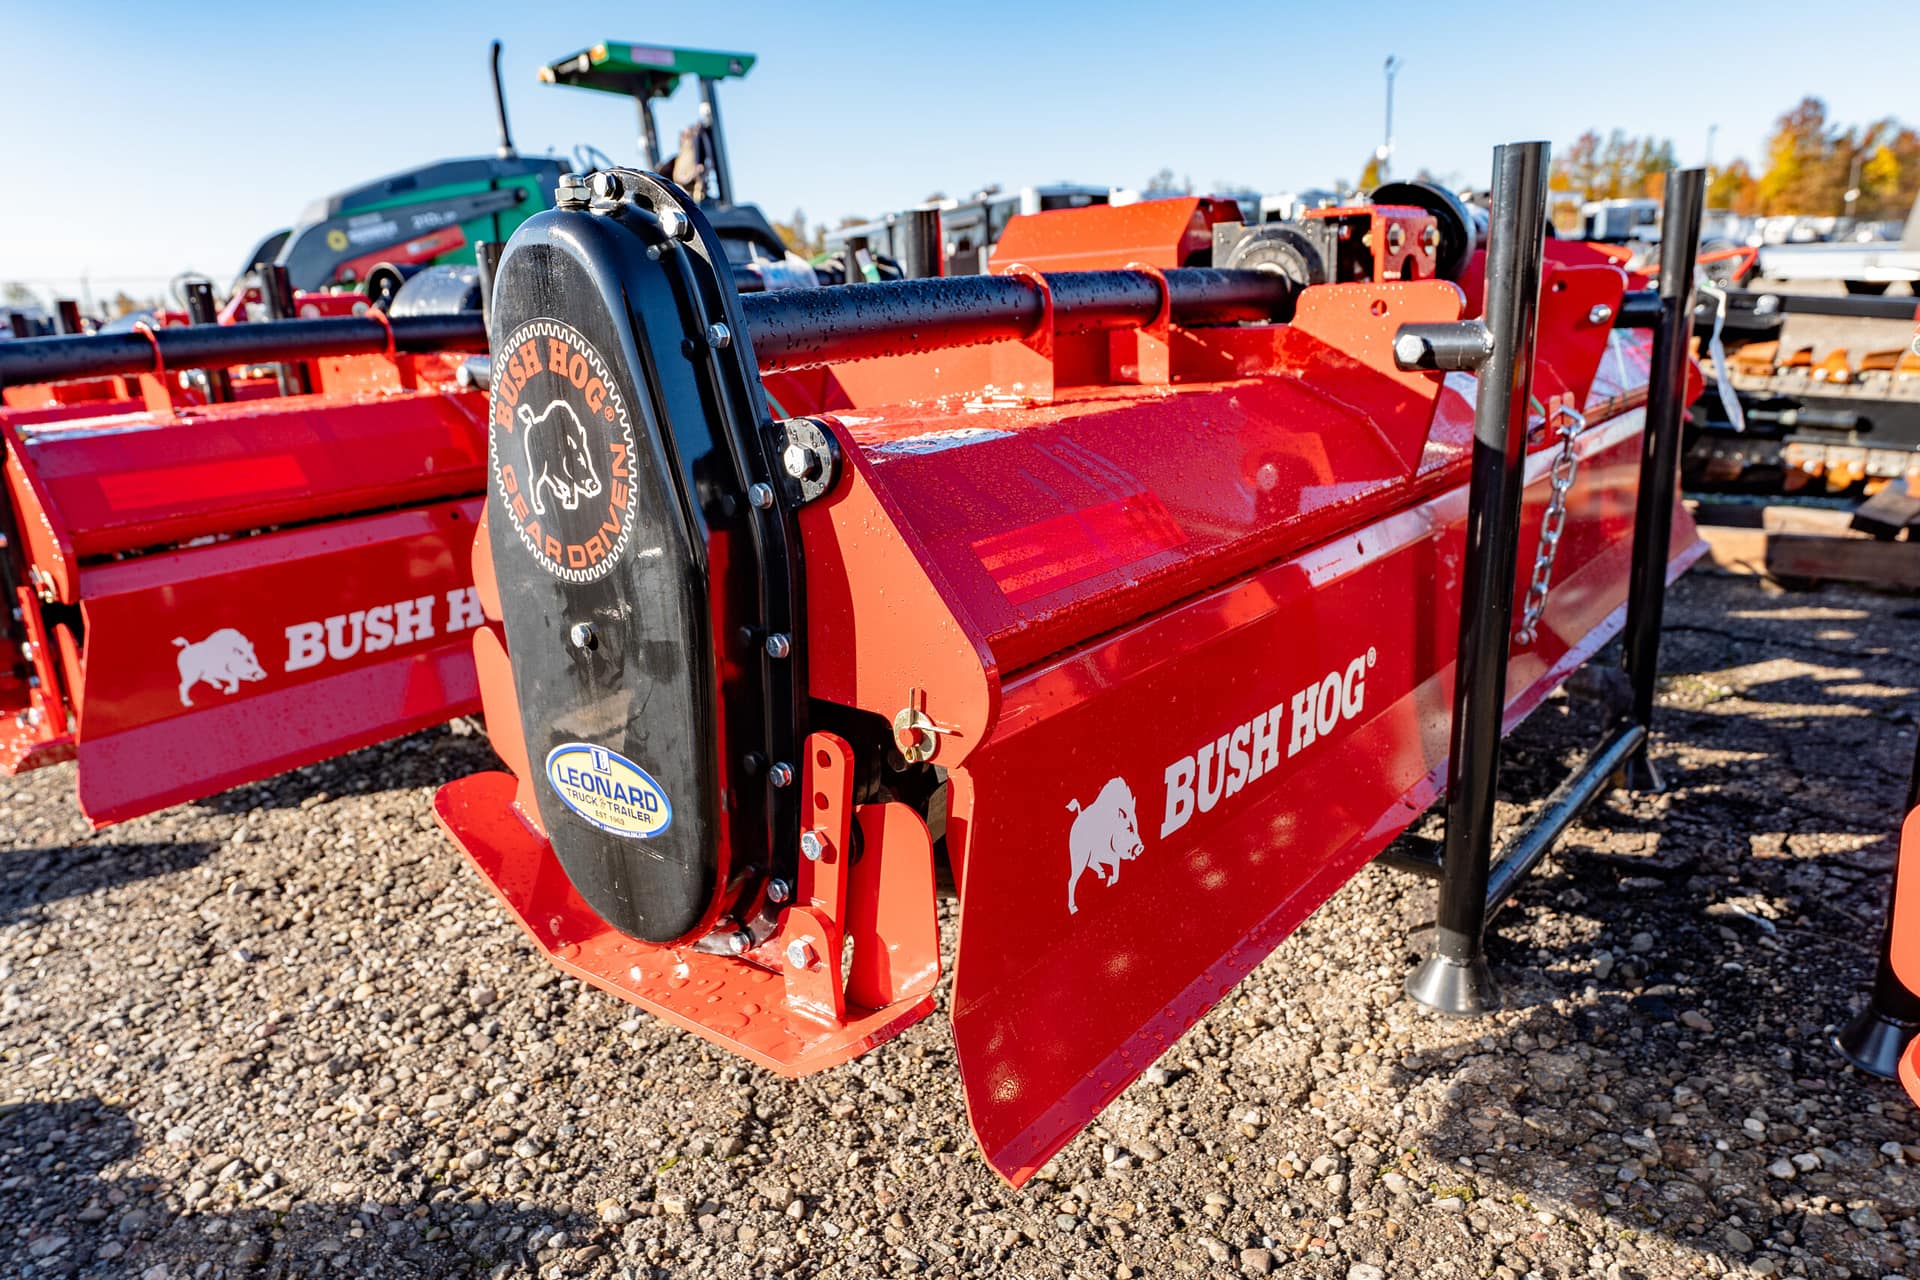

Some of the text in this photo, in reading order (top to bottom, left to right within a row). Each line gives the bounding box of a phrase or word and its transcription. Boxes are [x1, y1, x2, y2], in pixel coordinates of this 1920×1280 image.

[495, 338, 543, 434] BUSH
[502, 443, 629, 568] GEAR DRIVEN
[284, 595, 435, 672] BUSH
[556, 763, 658, 813] LEONARD
[566, 787, 598, 807] TRUCK
[606, 801, 651, 824] TRAILER
[1160, 702, 1283, 840] BUSH
